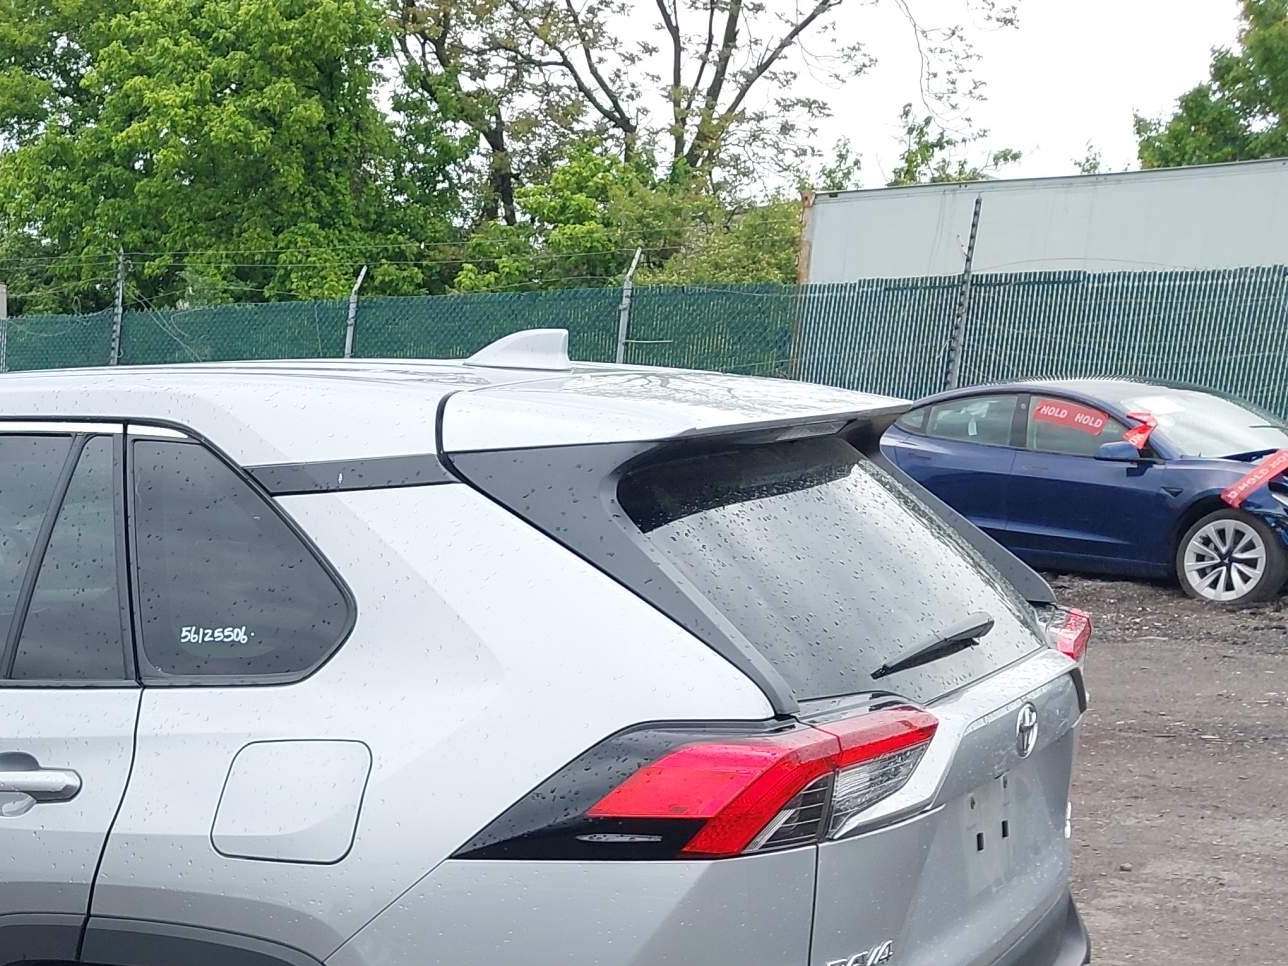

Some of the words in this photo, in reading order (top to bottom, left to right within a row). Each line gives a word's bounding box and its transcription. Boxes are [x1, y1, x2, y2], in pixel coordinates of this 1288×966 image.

[1040, 405, 1068, 418] HOLD
[1074, 412, 1103, 428] HOLD
[1237, 468, 1270, 491] HOLD
